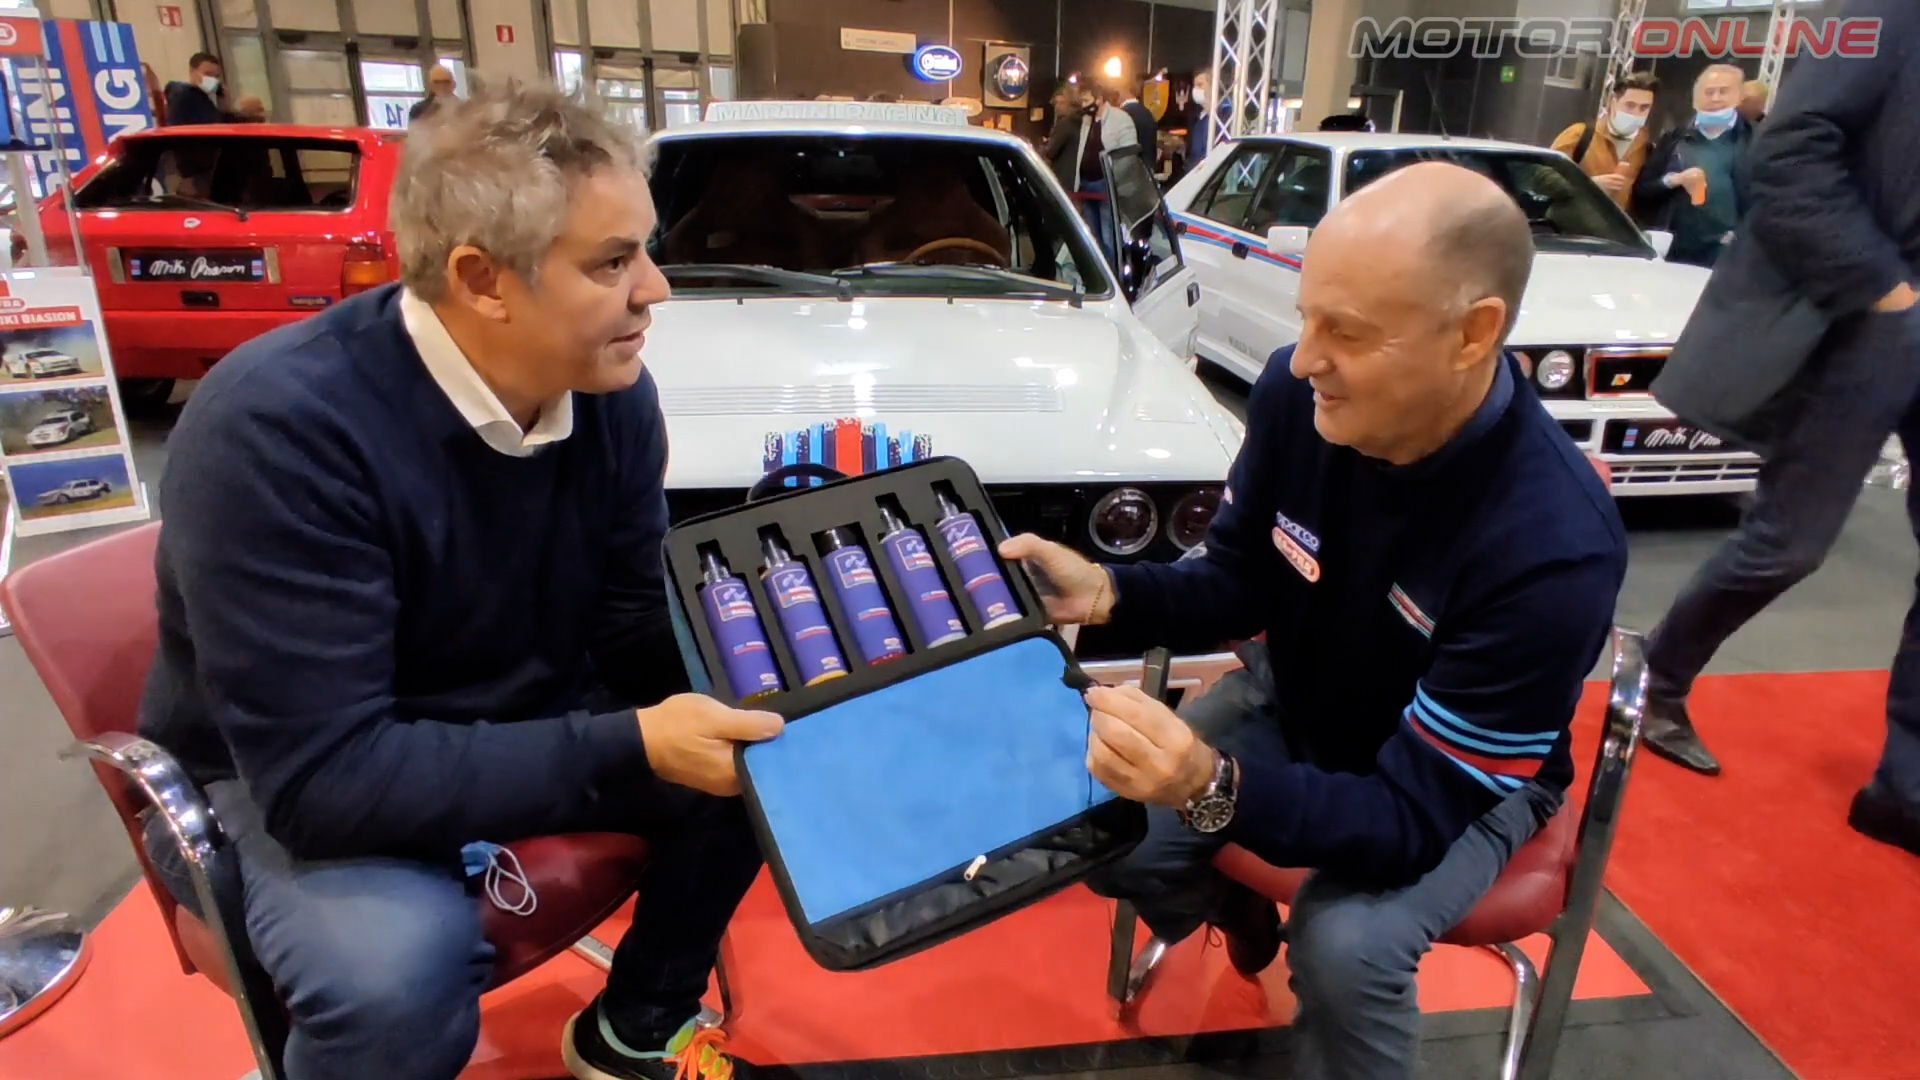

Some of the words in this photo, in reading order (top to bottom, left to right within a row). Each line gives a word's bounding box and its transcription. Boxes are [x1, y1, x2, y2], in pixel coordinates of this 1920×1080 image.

[717, 104, 838, 120] MARTINI
[844, 104, 957, 125] RACING
[21, 311, 77, 324] BIASION
